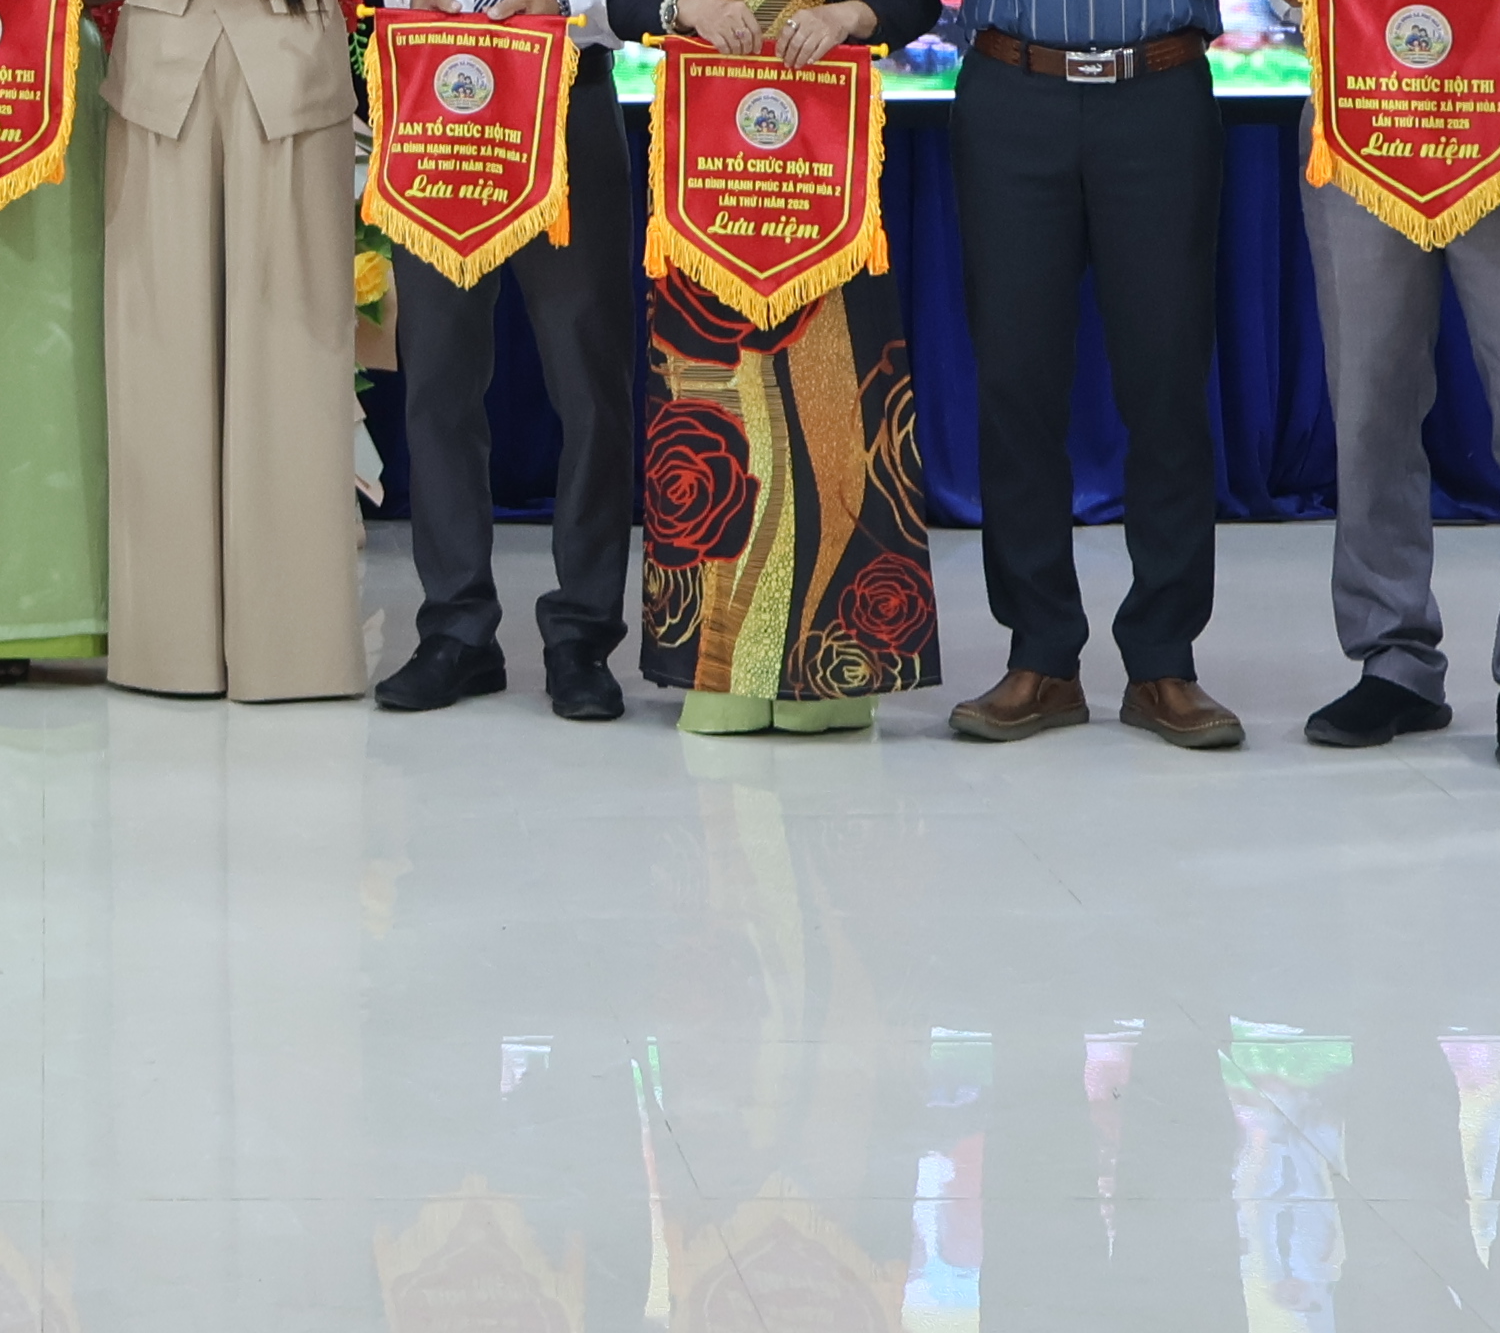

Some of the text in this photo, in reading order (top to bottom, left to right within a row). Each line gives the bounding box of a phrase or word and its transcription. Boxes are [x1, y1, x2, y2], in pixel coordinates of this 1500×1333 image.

[15, 69, 35, 83] THI
[705, 66, 725, 76] BAN
[757, 67, 777, 80] DÂN
[796, 70, 815, 82] PHÚ
[839, 75, 846, 85] 2
[1347, 71, 1494, 97] BAN TỔ CHỨC HỘI THI
[1338, 98, 1353, 108] GIA
[1411, 99, 1437, 110] PHÚC
[1456, 100, 1474, 112] PHÚ
[426, 116, 443, 135] TỔ
[446, 121, 482, 137] CHỨC
[485, 123, 503, 142] HỘI
[505, 129, 522, 144] THI
[1361, 132, 1481, 165] Lưu niệm
[698, 151, 833, 178] BAN TỔ CHỨC HỘI THI
[459, 179, 508, 206] niệm
[688, 178, 703, 188] GIA
[756, 179, 780, 192] PHÚC
[797, 181, 814, 194] PHÚ
[835, 186, 841, 197] 2
[788, 199, 810, 210] 2026
[707, 211, 820, 244] Lưu niệm
